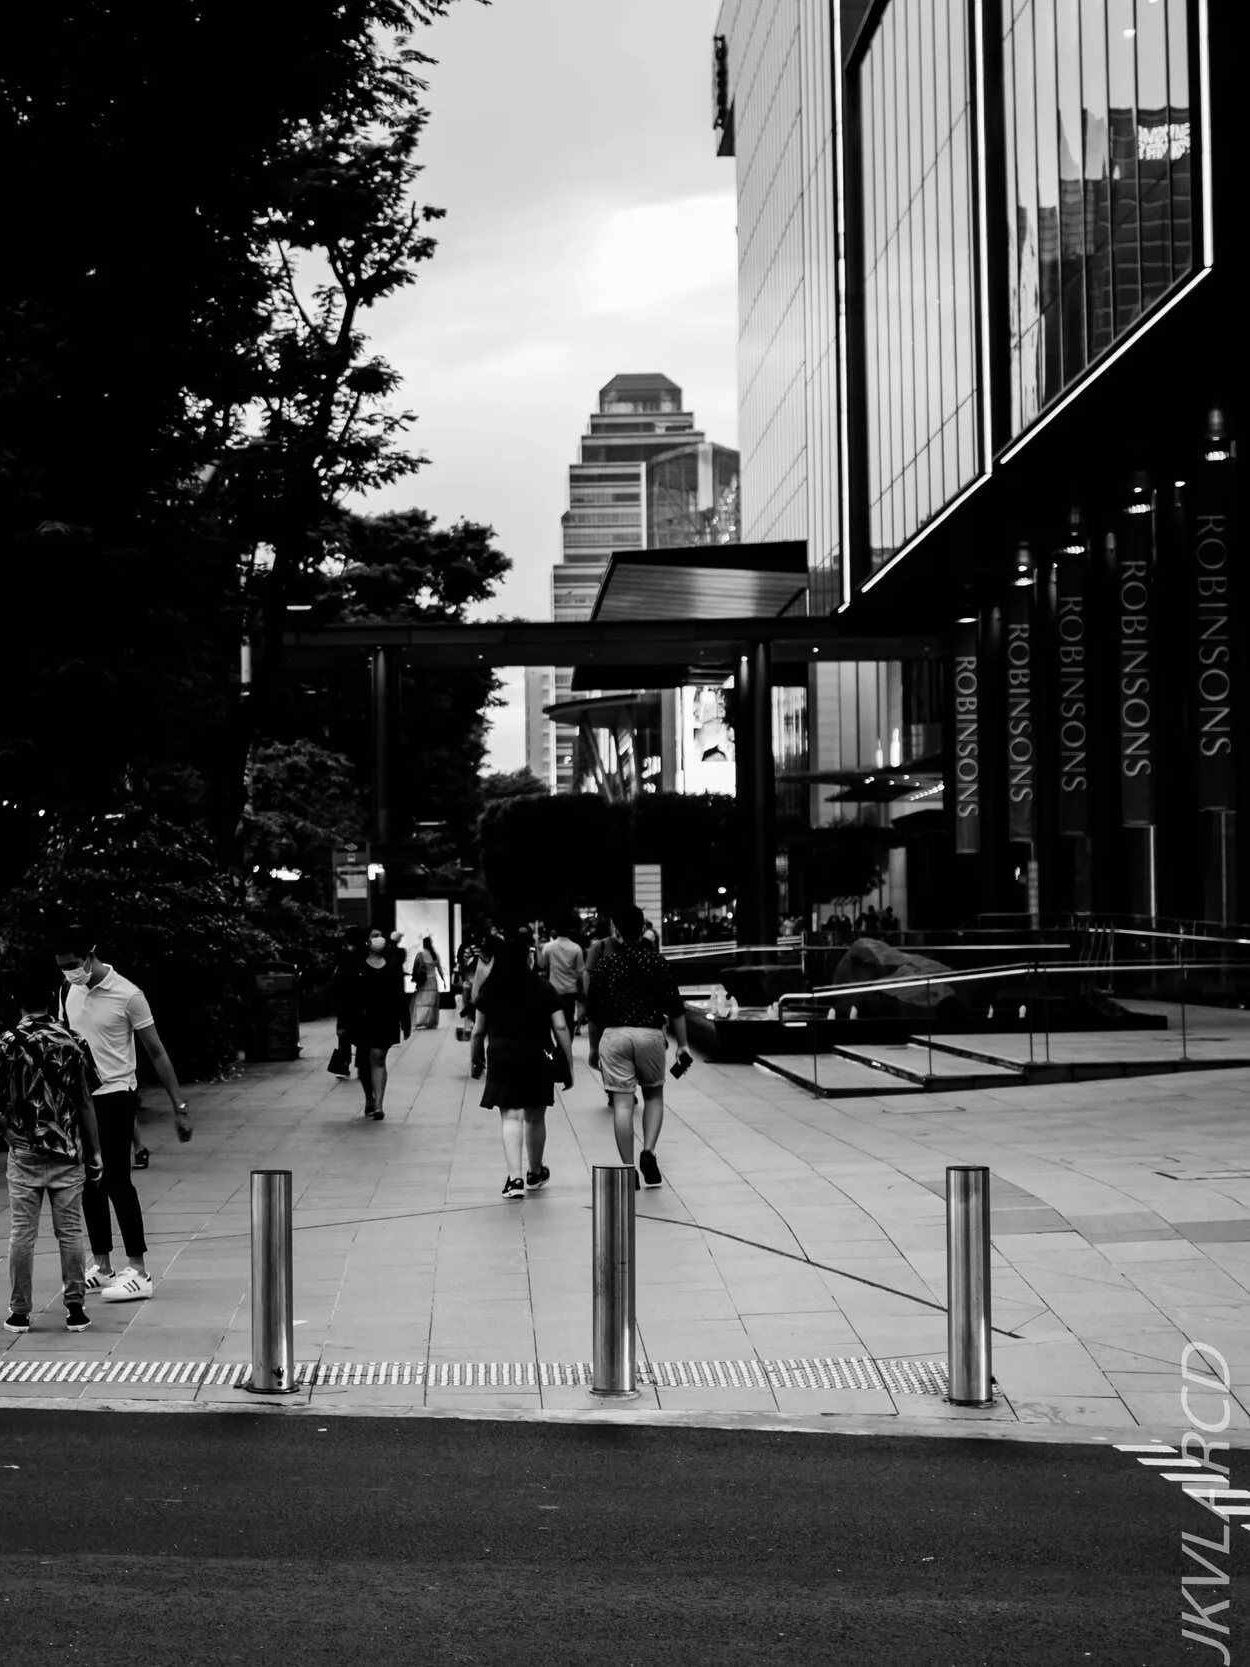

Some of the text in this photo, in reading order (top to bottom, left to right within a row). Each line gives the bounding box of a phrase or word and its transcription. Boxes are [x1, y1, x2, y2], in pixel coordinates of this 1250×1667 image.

[1008, 623, 1033, 802] ROBINSONS
[1059, 596, 1087, 792] ROBINSONS
[1120, 560, 1151, 777] ROBINSONS
[1196, 515, 1231, 756] ROBINSONS
[955, 656, 978, 817] ROBINSONS
